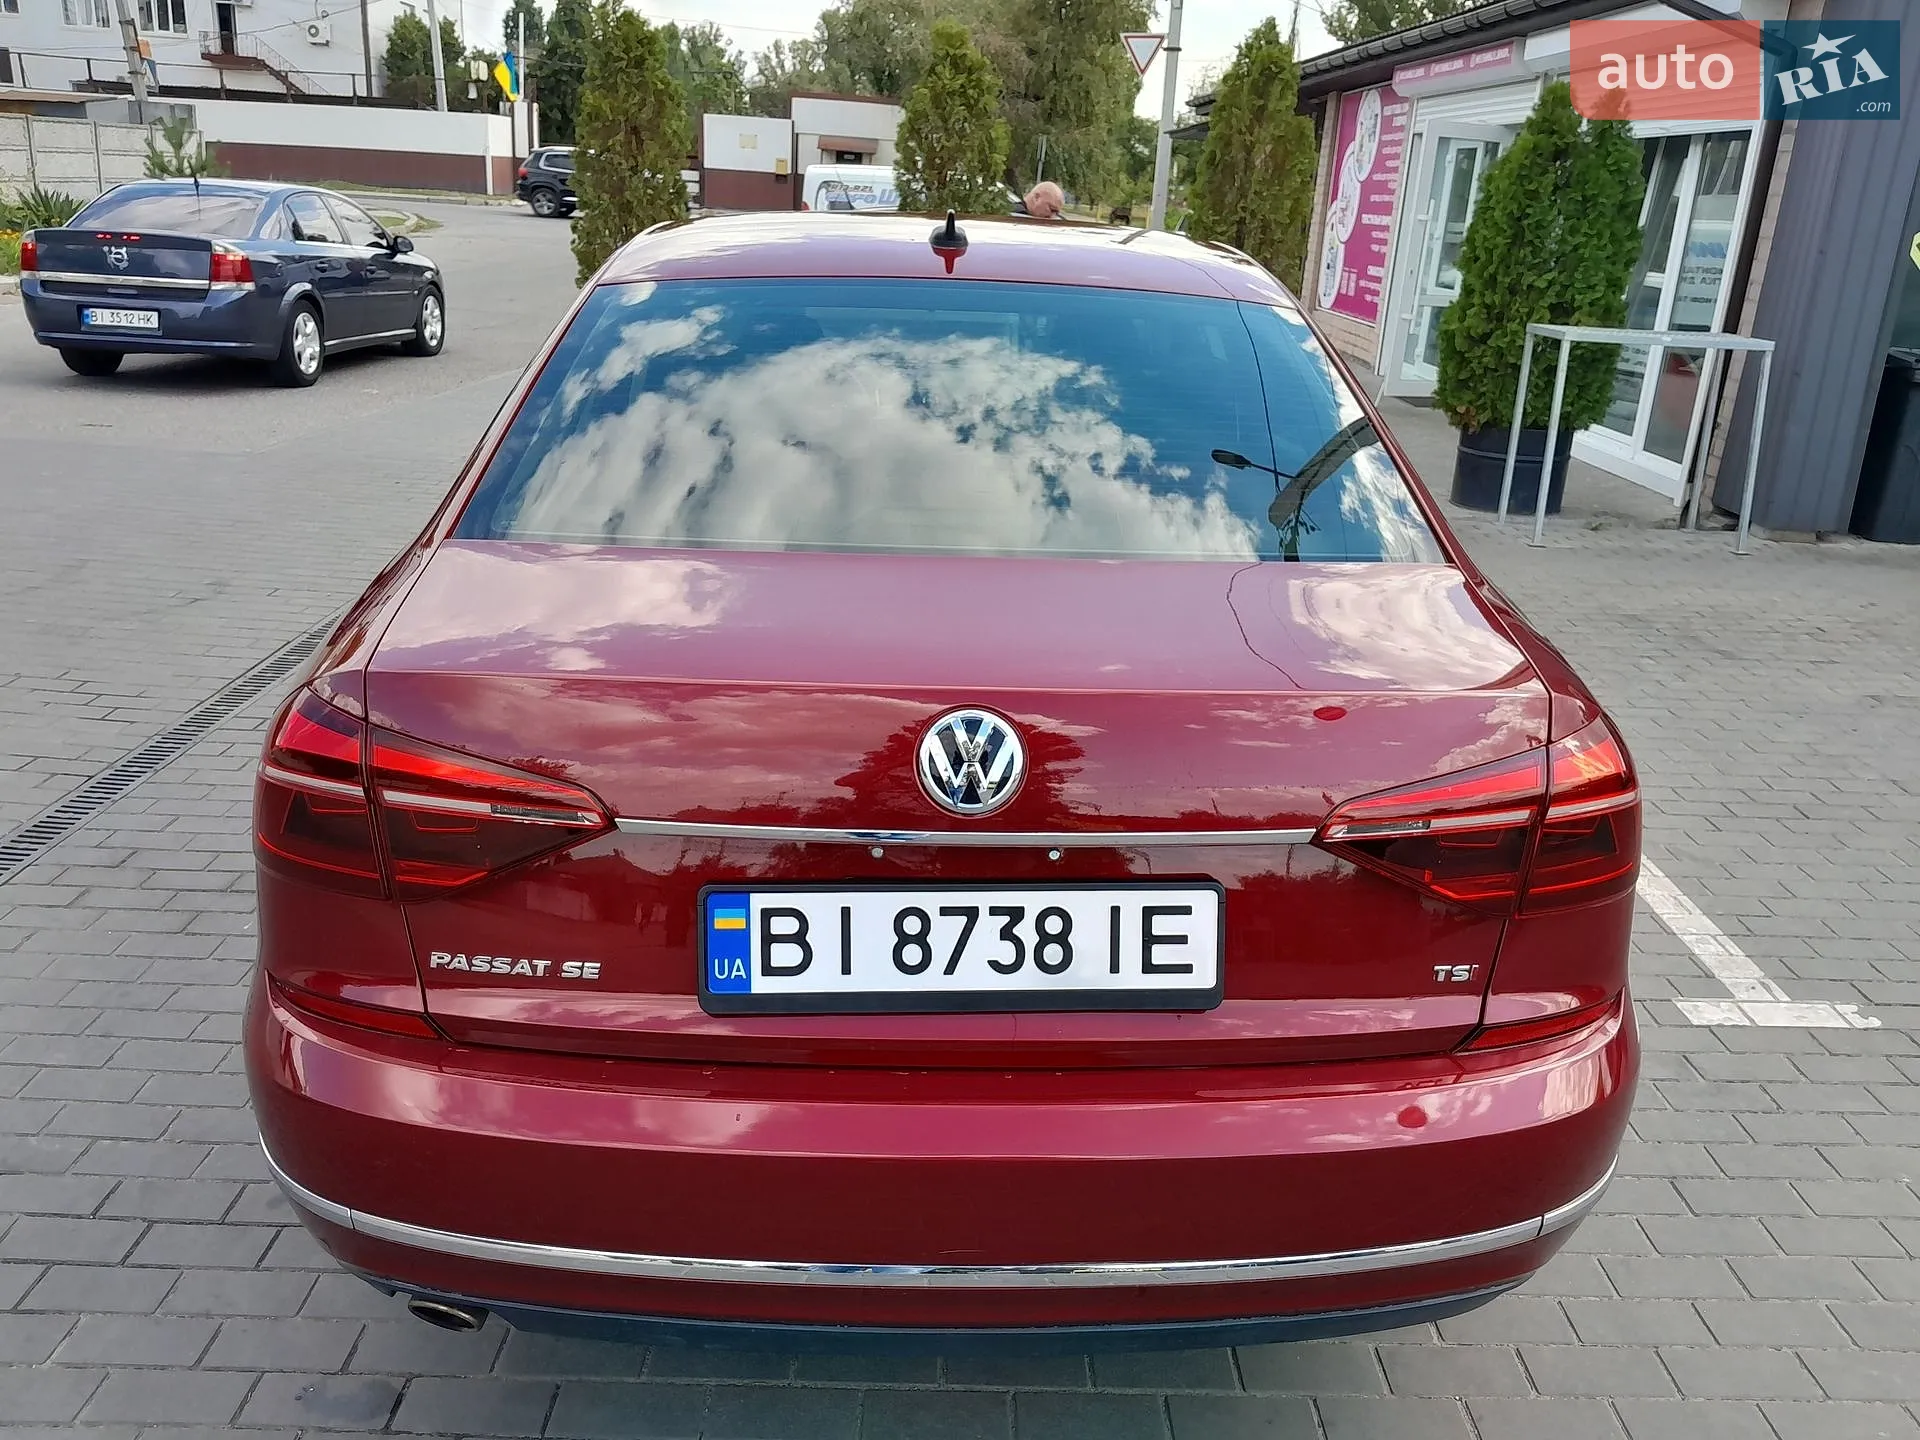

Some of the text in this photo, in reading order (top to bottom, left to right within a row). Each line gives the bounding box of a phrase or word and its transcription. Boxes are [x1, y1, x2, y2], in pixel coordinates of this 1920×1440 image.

[91, 310, 104, 323] BI
[138, 313, 154, 326] HK
[760, 904, 1194, 977] BI 8738 IE
[429, 951, 602, 980] PASSAT SE
[714, 957, 747, 980] UA
[1433, 964, 1480, 982] TSI
